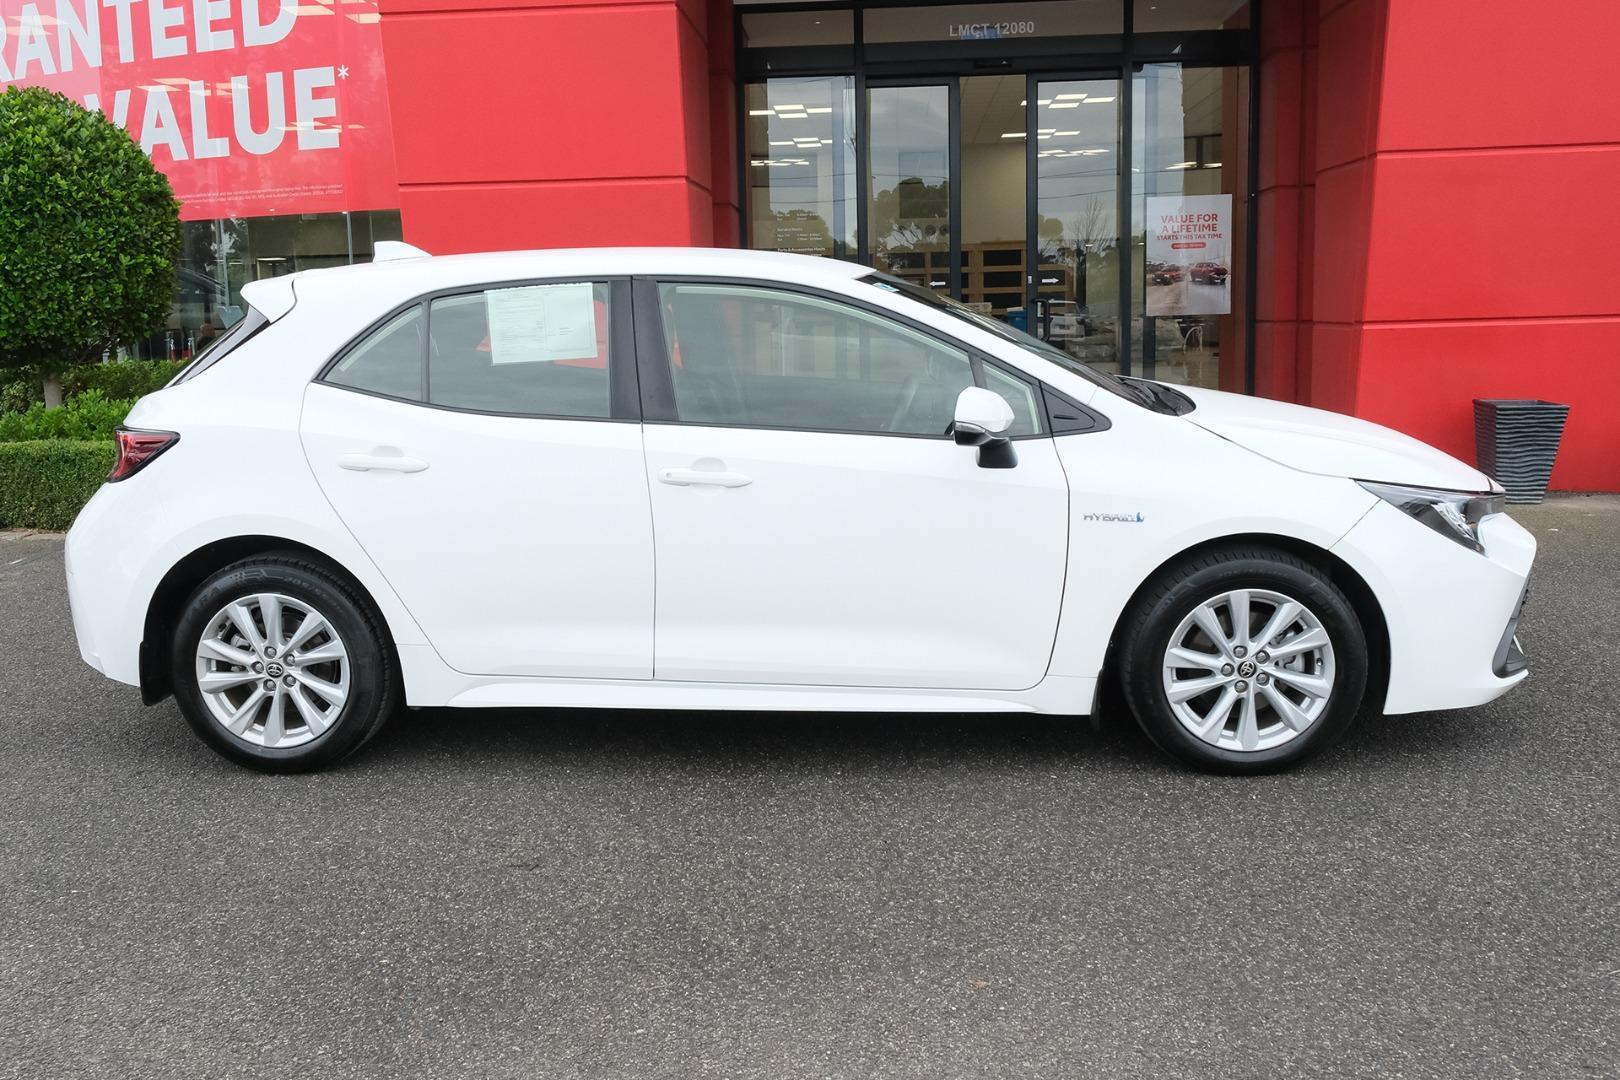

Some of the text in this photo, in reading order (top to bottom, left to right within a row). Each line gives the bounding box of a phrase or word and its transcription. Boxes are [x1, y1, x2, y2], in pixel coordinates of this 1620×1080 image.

[949, 21, 1035, 37] LMCT 12080
[1161, 213, 1218, 224] VALUE FOR
[1161, 223, 1217, 233] A LIFETIME
[1083, 513, 1136, 522] HYBRID
